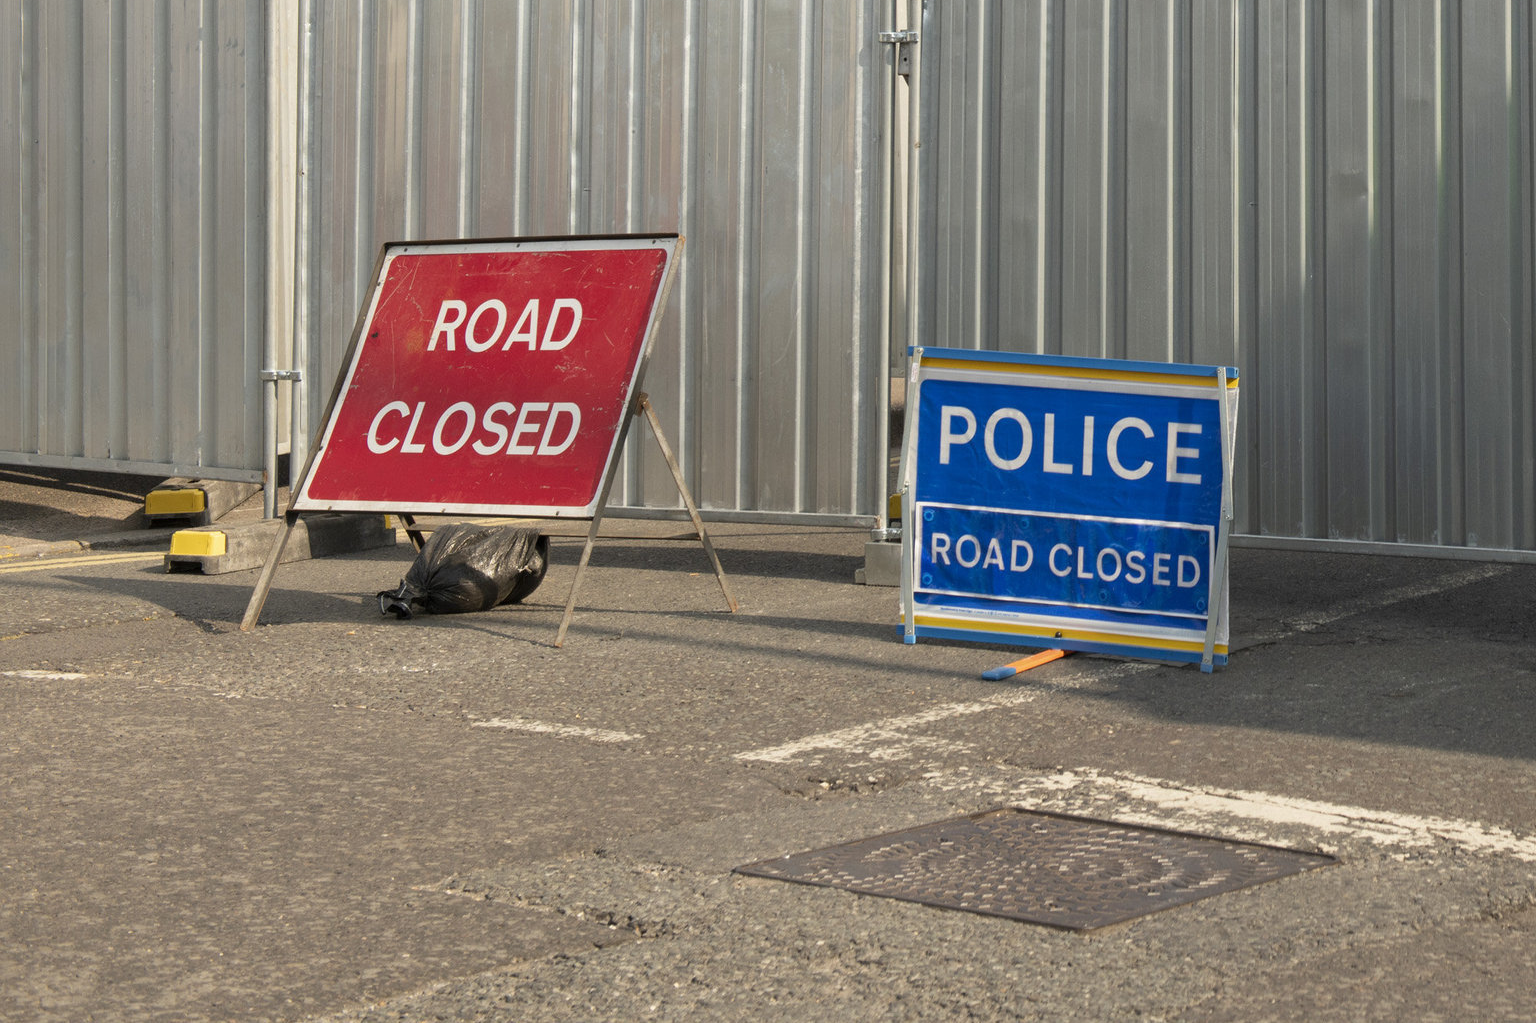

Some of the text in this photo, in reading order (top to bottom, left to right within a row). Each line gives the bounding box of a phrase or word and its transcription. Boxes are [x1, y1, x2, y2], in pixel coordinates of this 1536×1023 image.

[426, 297, 583, 353] ROAD
[366, 400, 582, 456] CLOSED
[938, 404, 1203, 485] POLICE
[930, 531, 1201, 589] ROAD CLOSED
